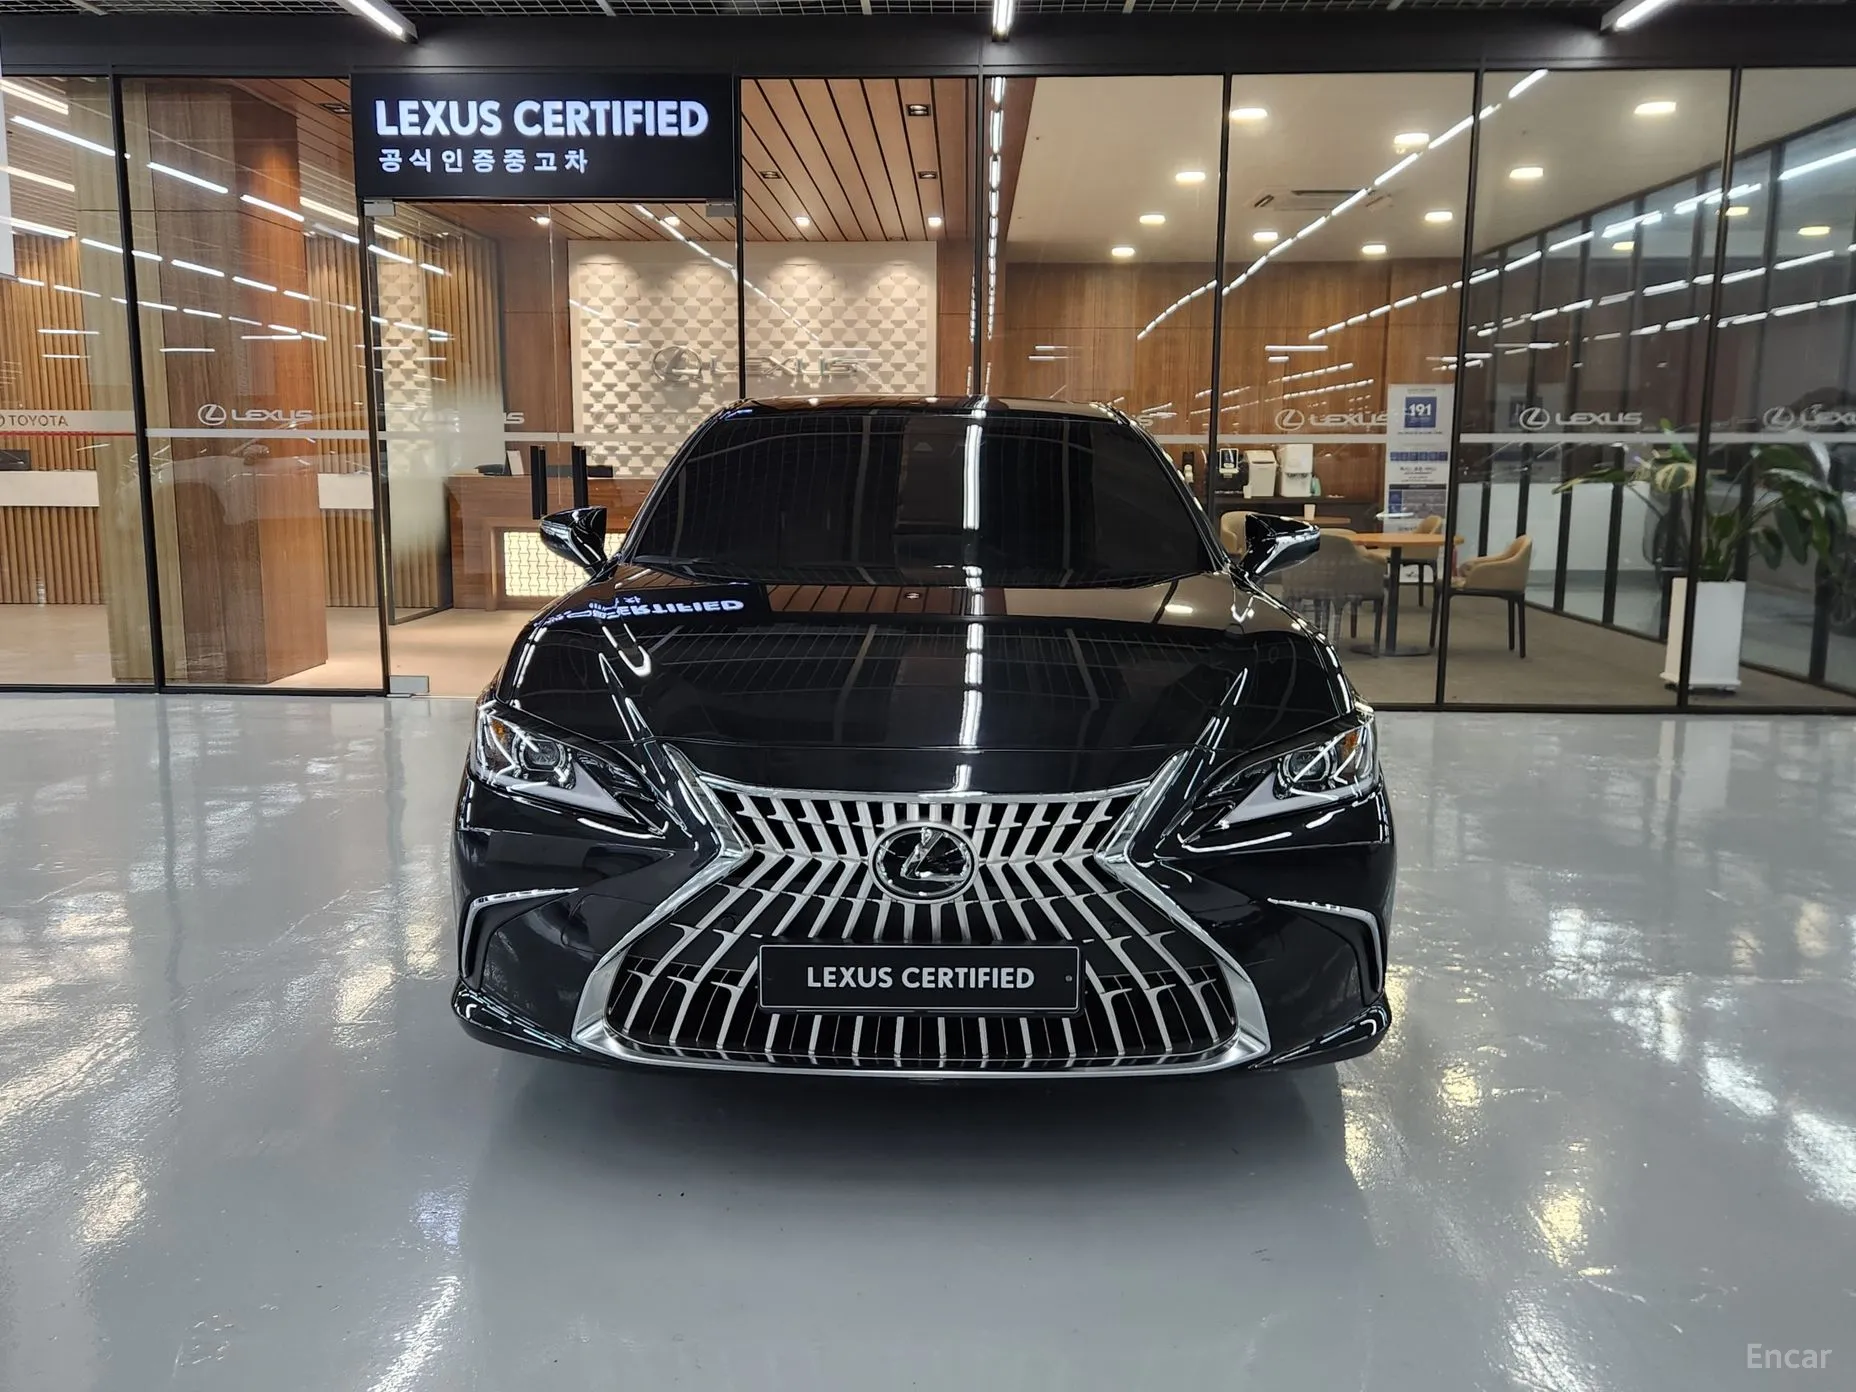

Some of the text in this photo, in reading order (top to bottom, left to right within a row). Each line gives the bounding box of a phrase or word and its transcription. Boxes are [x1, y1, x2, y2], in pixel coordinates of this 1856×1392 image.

[374, 99, 709, 137] LEXUS CERTIFIED
[378, 148, 589, 173] 공식인증중고차
[231, 409, 313, 422] LEXUS
[1409, 403, 1432, 417] 191
[8, 414, 69, 427] TOYOTA
[1309, 413, 1388, 427] LEXUS
[1555, 412, 1642, 426] LEXUS
[807, 967, 1035, 989] LEXUS CERTIFIED
